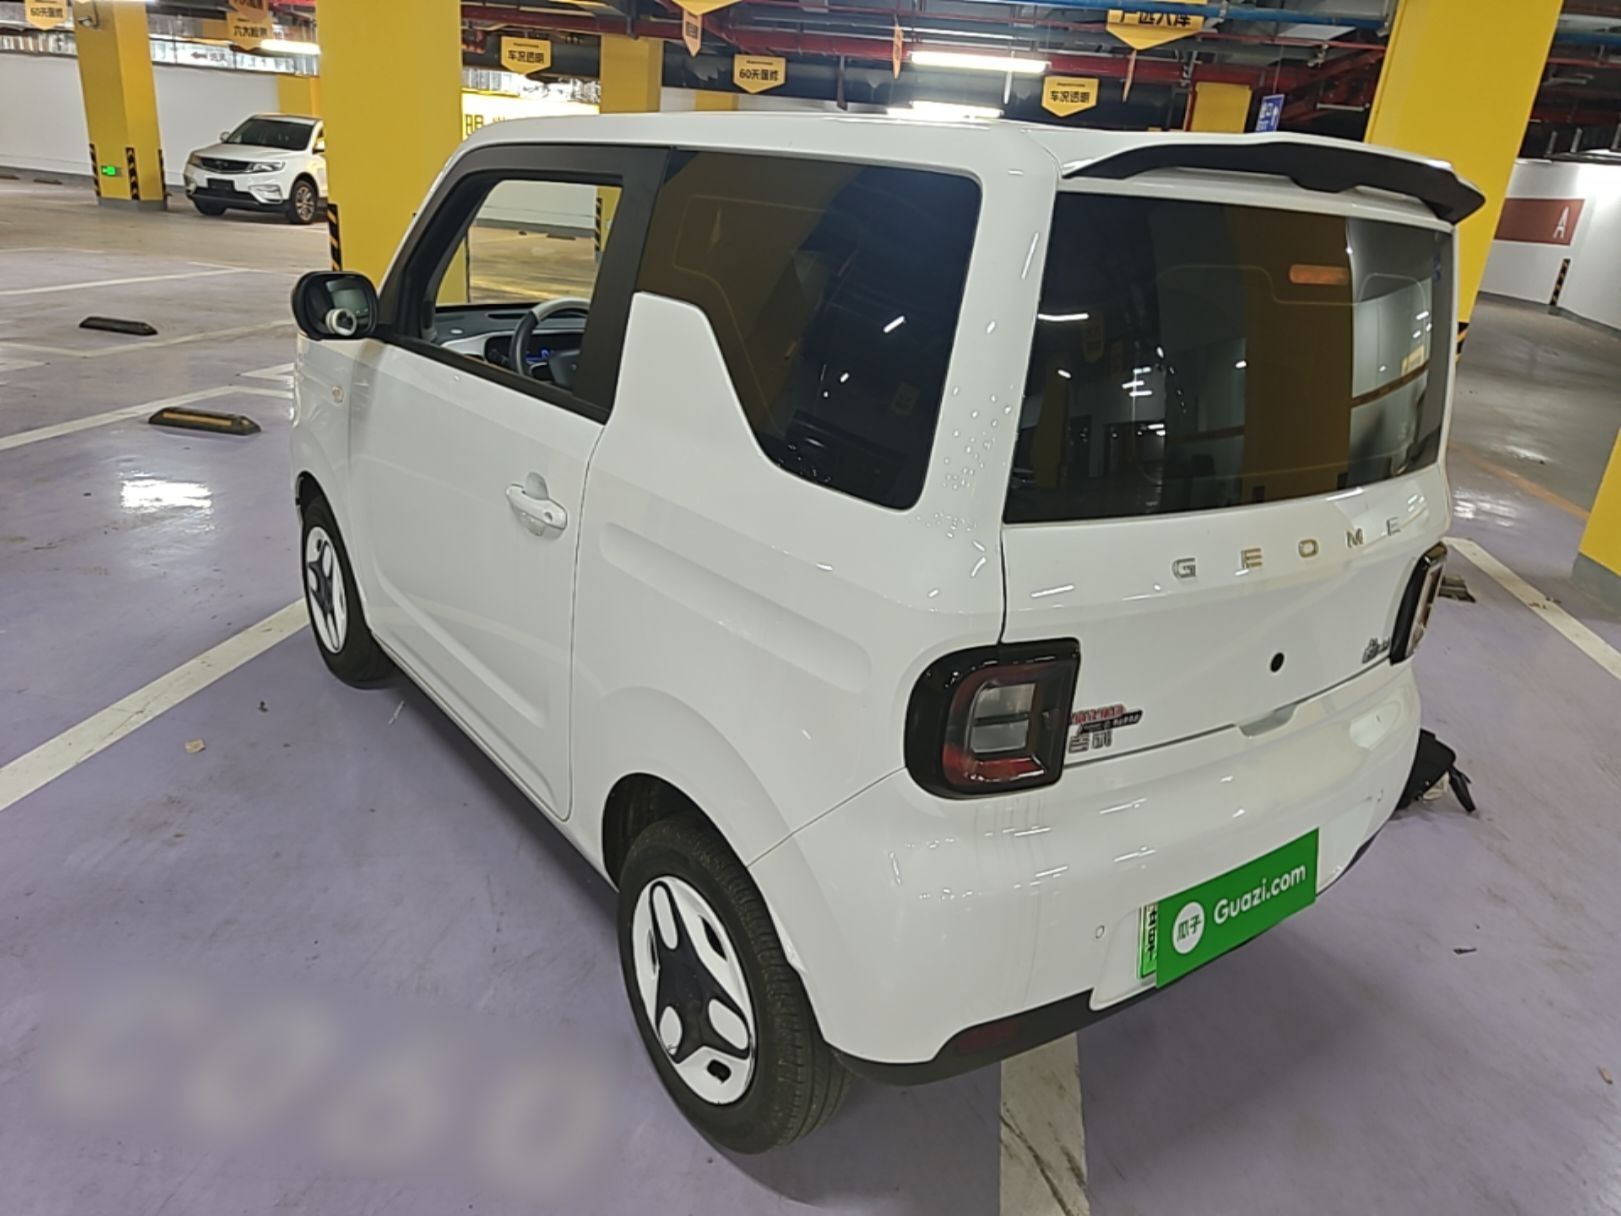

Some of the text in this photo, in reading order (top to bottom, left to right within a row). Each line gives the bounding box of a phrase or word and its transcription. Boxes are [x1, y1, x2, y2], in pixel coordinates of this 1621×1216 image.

[508, 50, 545, 65] 车况透明
[1050, 90, 1091, 103] 车况透明
[1553, 206, 1569, 239] A
